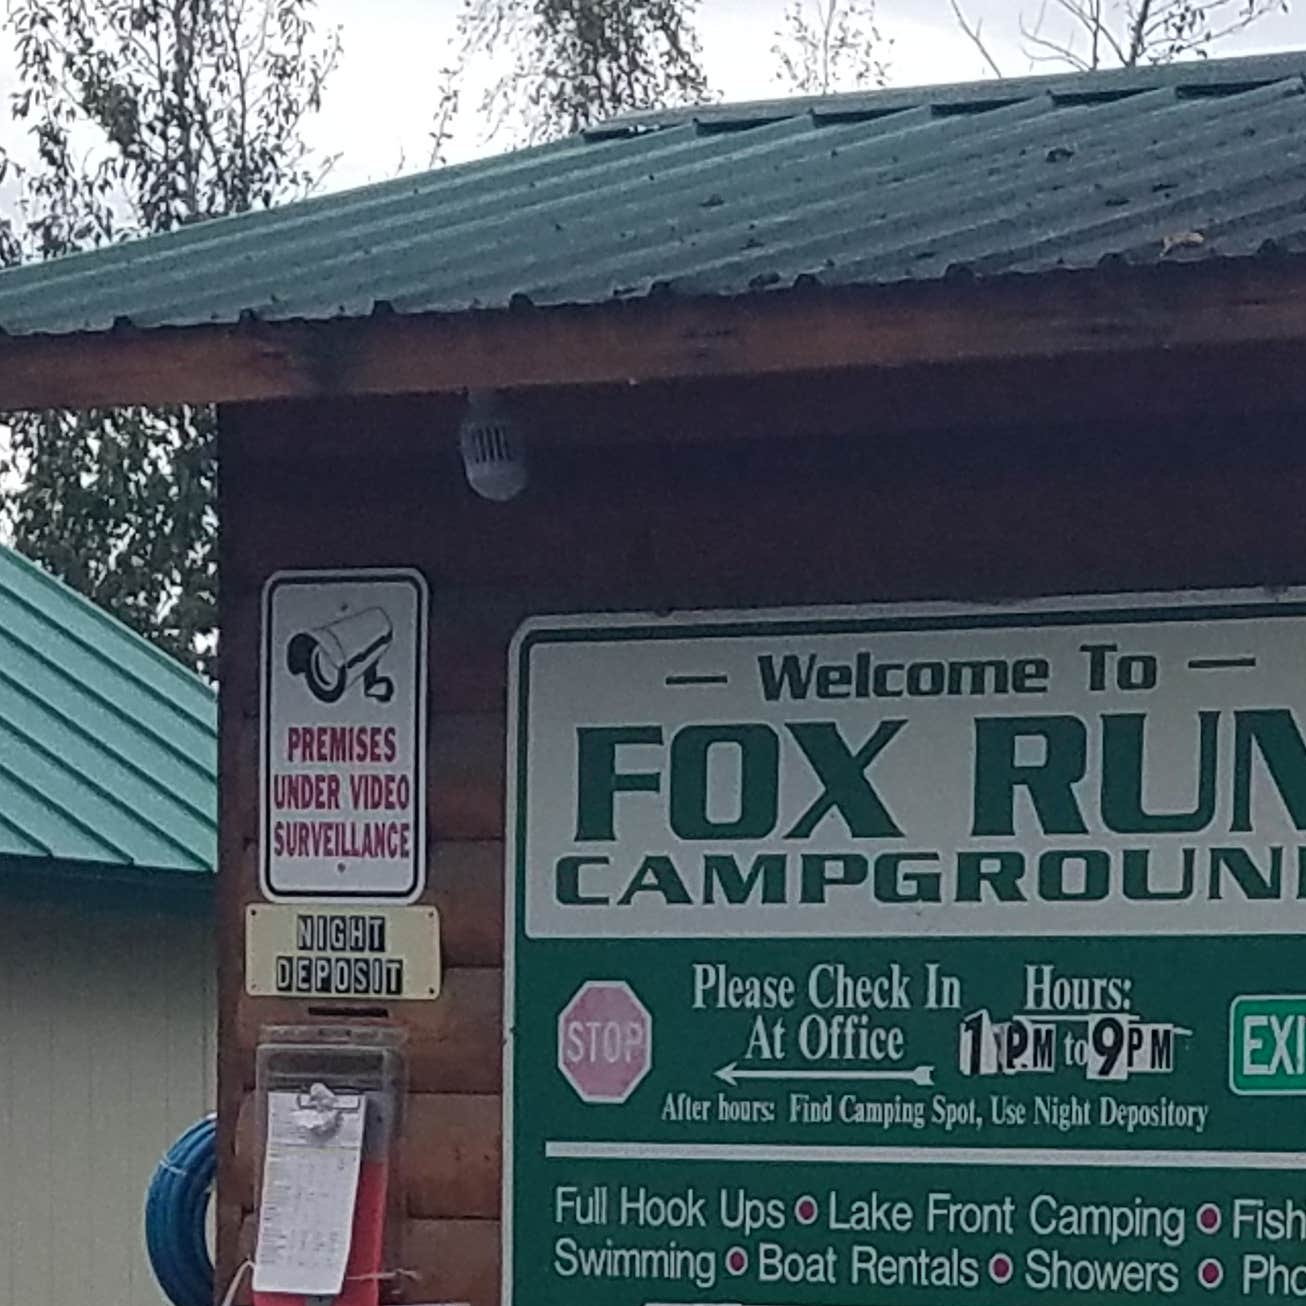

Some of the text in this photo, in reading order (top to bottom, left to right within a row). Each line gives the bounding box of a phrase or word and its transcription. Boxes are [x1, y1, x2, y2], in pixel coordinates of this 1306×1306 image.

[758, 643, 1157, 702] Welcome To
[287, 727, 397, 763] PREMISES
[274, 774, 410, 810] UNDER VIDEO
[574, 718, 908, 843] FOX
[273, 821, 410, 859] SURVEILLANCE
[297, 915, 385, 951] NIGHT
[277, 957, 402, 994] DEPOSIT
[692, 963, 961, 1009] Please Check In
[1024, 964, 1132, 1011] Hours:
[566, 1021, 644, 1064] STOP
[745, 1014, 904, 1061] At Office
[1064, 1032, 1087, 1066] to
[661, 1092, 711, 1122] After
[789, 1093, 832, 1124] Find
[839, 1095, 924, 1129] Camping
[931, 1095, 983, 1131] Spot,
[991, 1096, 1026, 1125] Use
[1034, 1096, 1091, 1131] Night
[1100, 1096, 1208, 1133] Depository
[554, 1186, 608, 1225] Full
[620, 1189, 706, 1229] Hook
[721, 1193, 785, 1237] Ups
[829, 1192, 914, 1233] Lake
[927, 1194, 1015, 1236] Front
[1028, 1195, 1186, 1246] Camping
[554, 1239, 715, 1289] Swimming
[759, 1246, 838, 1285] Boat
[851, 1248, 979, 1289] Rentals
[1024, 1251, 1179, 1293] Showers
